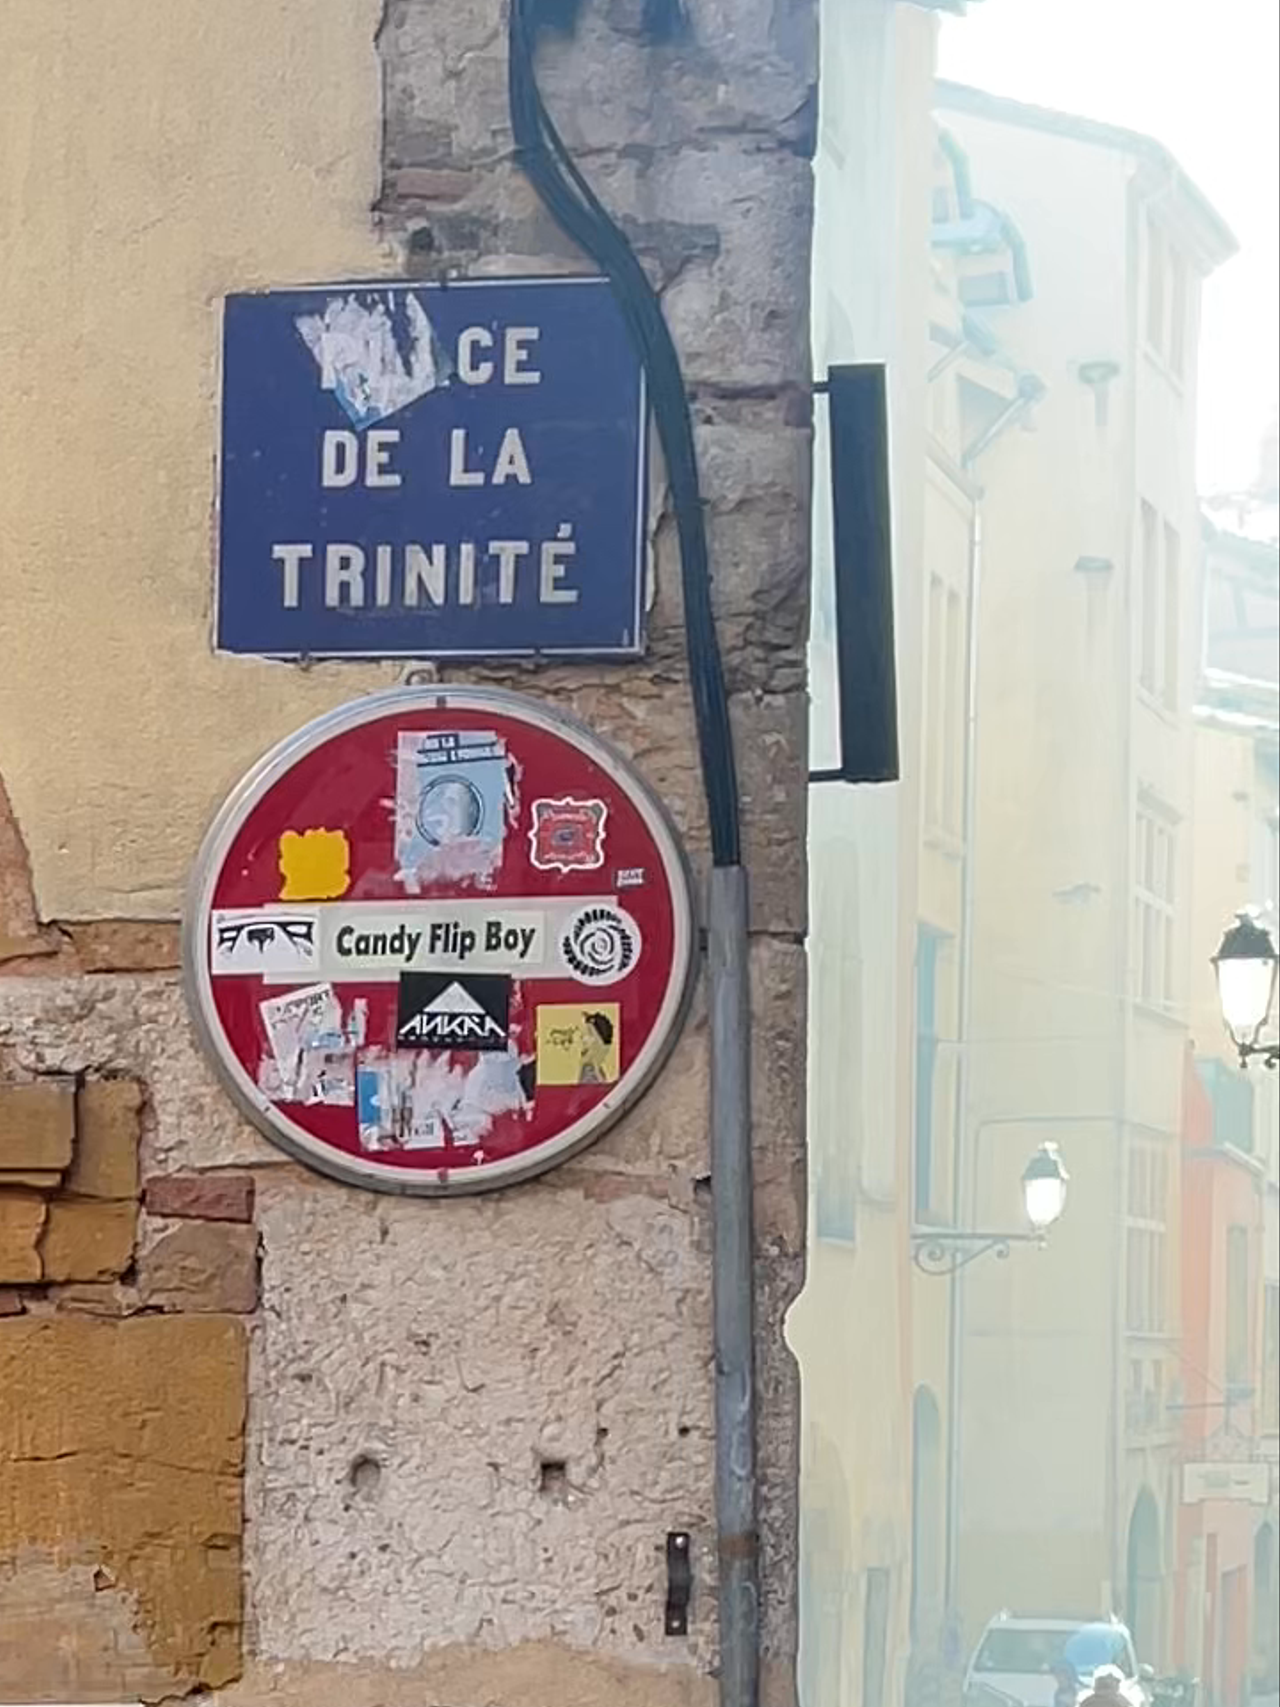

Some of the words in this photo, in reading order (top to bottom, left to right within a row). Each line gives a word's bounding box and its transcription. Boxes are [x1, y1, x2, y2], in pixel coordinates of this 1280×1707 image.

[321, 425, 402, 488] DE
[449, 427, 532, 487] LA
[272, 523, 579, 608] TRINITÉ
[336, 924, 422, 963] Candy
[429, 921, 476, 961] Flip
[484, 921, 536, 959] Boy
